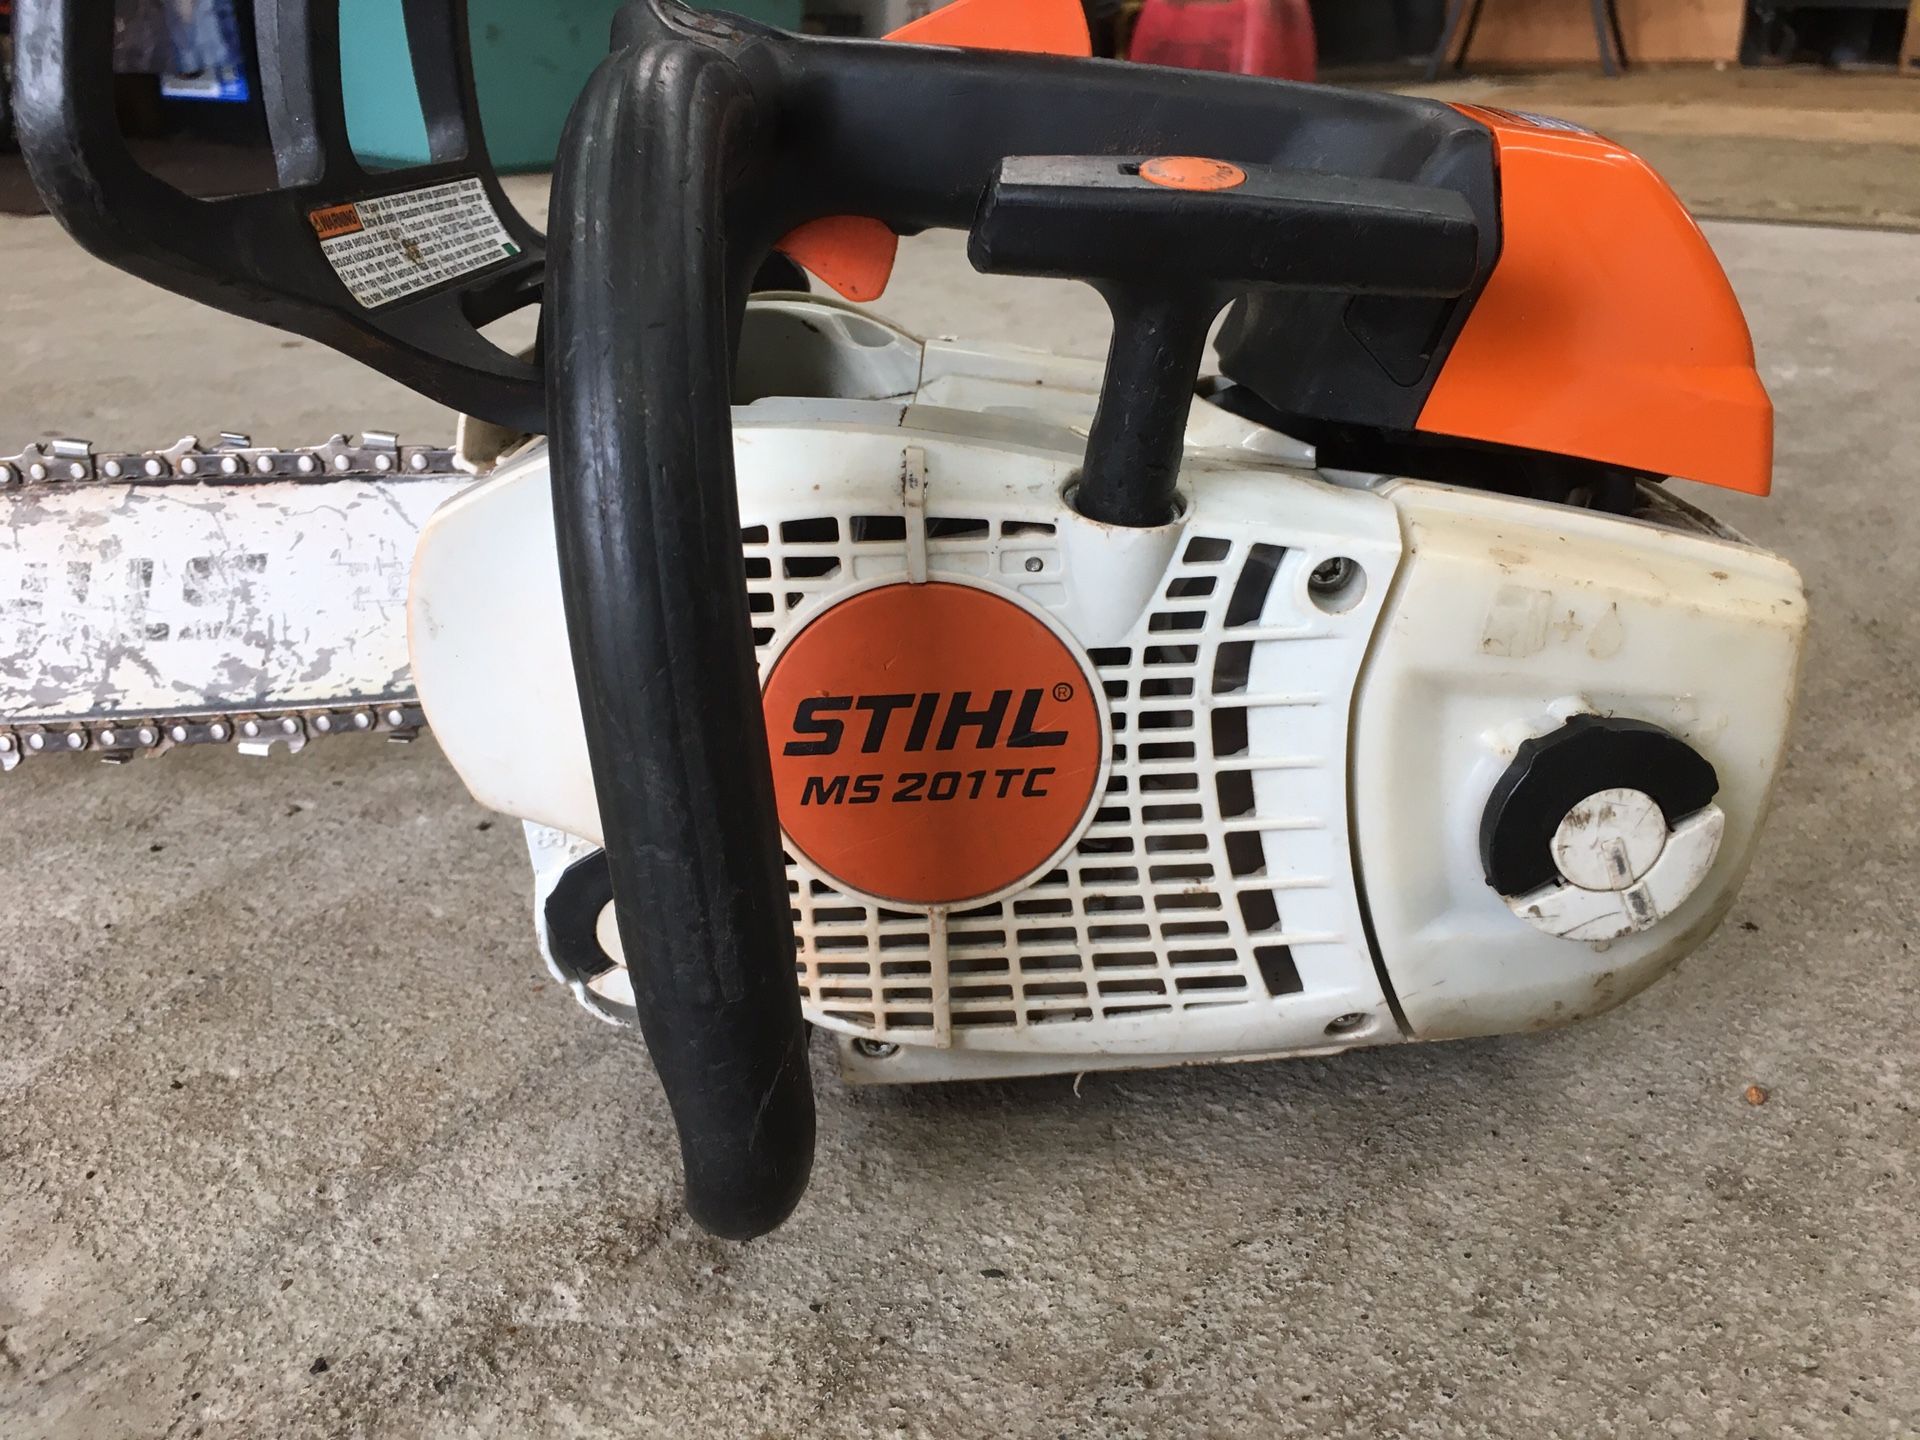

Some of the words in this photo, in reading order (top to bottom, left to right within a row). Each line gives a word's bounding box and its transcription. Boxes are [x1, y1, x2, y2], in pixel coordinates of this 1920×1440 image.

[321, 210, 358, 231] WARNING
[783, 688, 1069, 756] STIHL
[800, 774, 884, 806] MS
[892, 767, 1056, 802] 201TC
